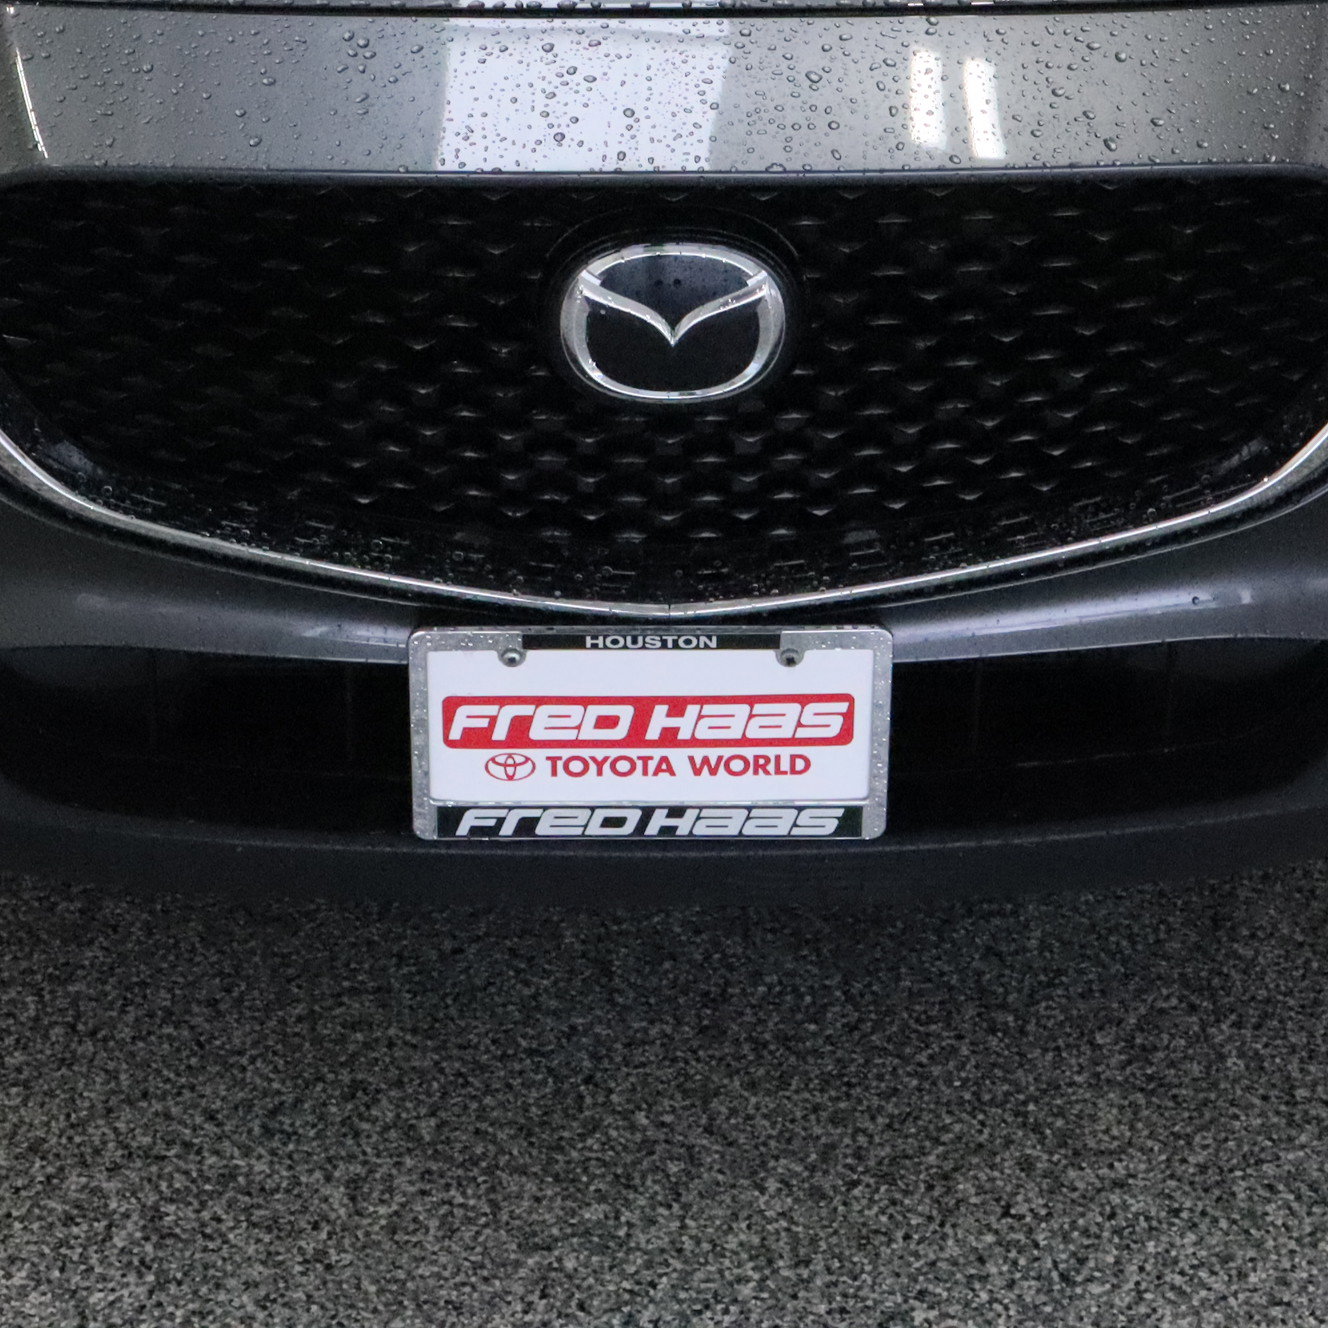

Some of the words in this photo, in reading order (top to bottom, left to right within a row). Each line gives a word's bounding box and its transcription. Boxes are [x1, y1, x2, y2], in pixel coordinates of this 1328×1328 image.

[585, 635, 718, 649] HOUSTON
[546, 755, 677, 778] TOYOTA
[687, 753, 812, 777] WORLD
